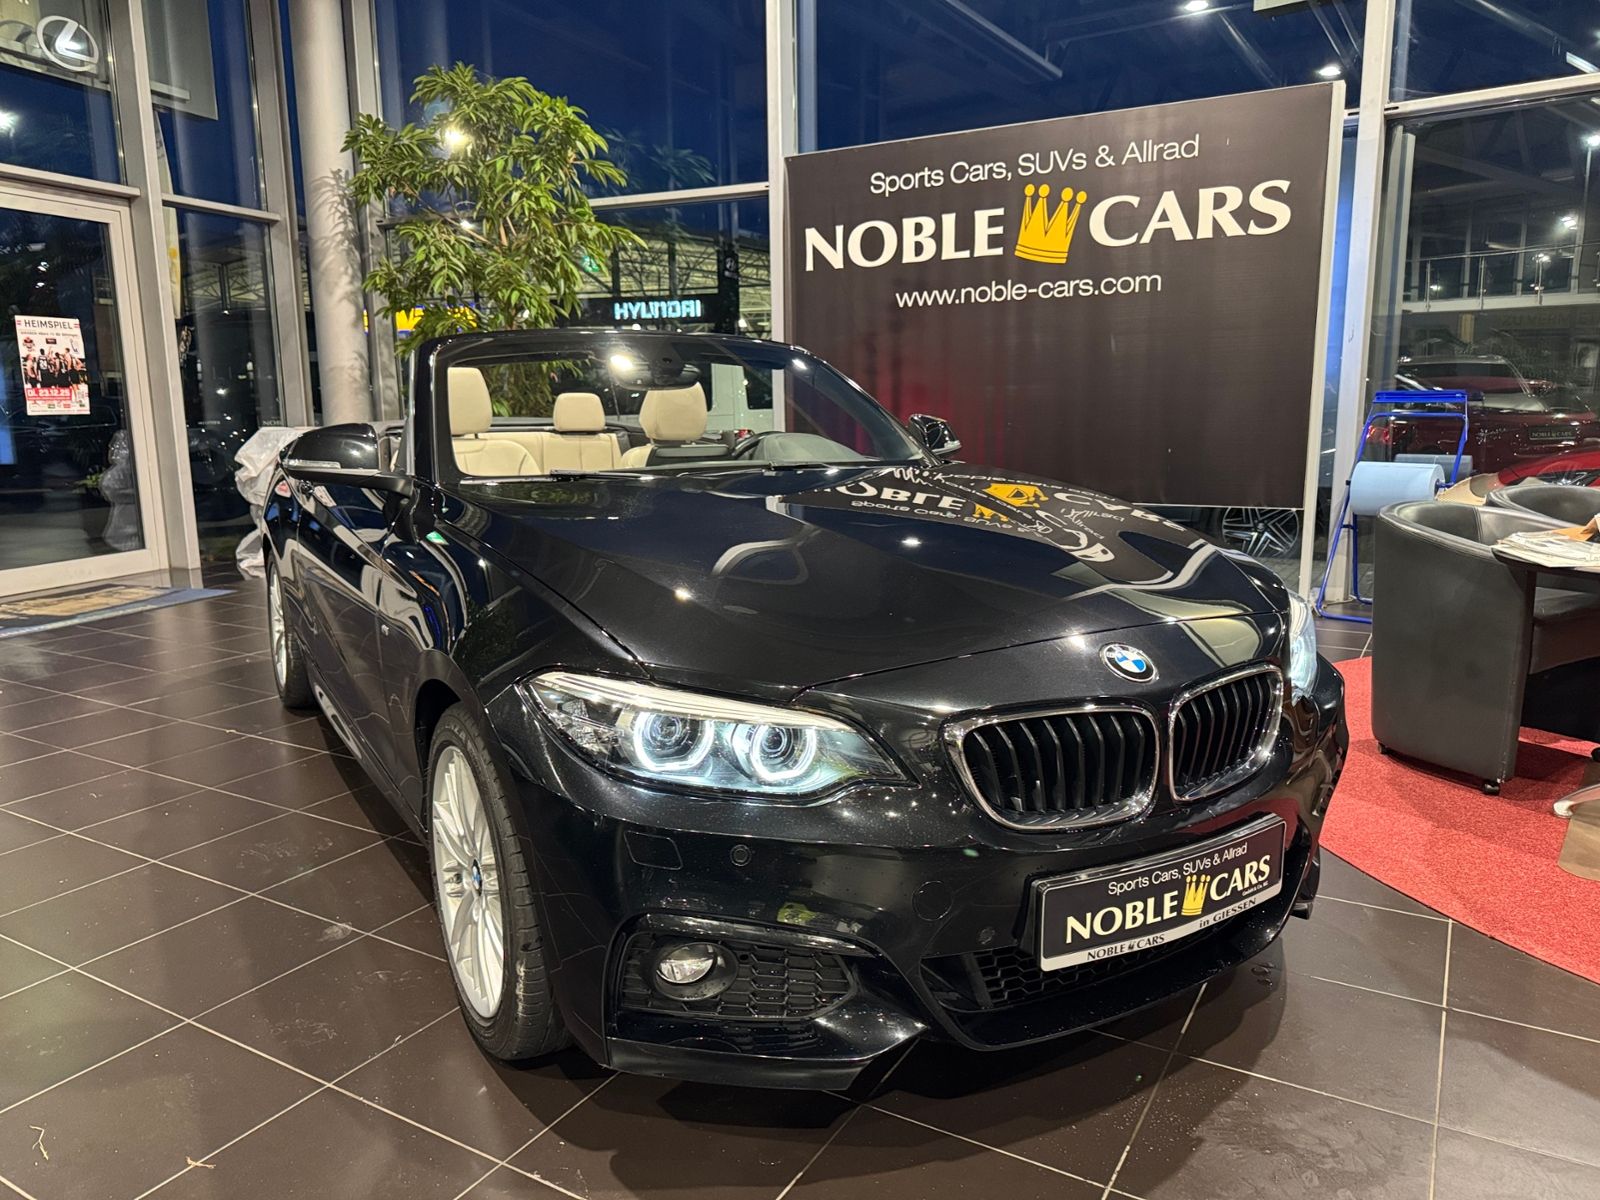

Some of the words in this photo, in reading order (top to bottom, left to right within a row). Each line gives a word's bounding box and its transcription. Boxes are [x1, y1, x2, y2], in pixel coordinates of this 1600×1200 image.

[869, 167, 945, 197] Sports
[949, 160, 1012, 186] Cars,
[1017, 148, 1087, 177] SUVs
[1095, 144, 1116, 167] &
[1121, 134, 1200, 165] Allrad
[804, 207, 1006, 272] NOBLE
[1088, 179, 1292, 247] CARS
[614, 299, 702, 320] HYUNDAI
[895, 274, 1163, 308] www.noble-cars.com
[24, 318, 73, 330] HEIMSPIEL
[1108, 875, 1149, 896] Sports
[1151, 868, 1182, 887] Cars,
[1183, 857, 1212, 876] SUVs
[1212, 854, 1221, 866] &
[1222, 842, 1248, 863] Allrad
[1065, 891, 1178, 944] NOBLE
[1209, 854, 1271, 901] CARS
[1086, 943, 1126, 961] NOBLE
[1136, 934, 1165, 949] CARS
[1199, 916, 1209, 928] in
[1213, 897, 1257, 923] GIESSEN
